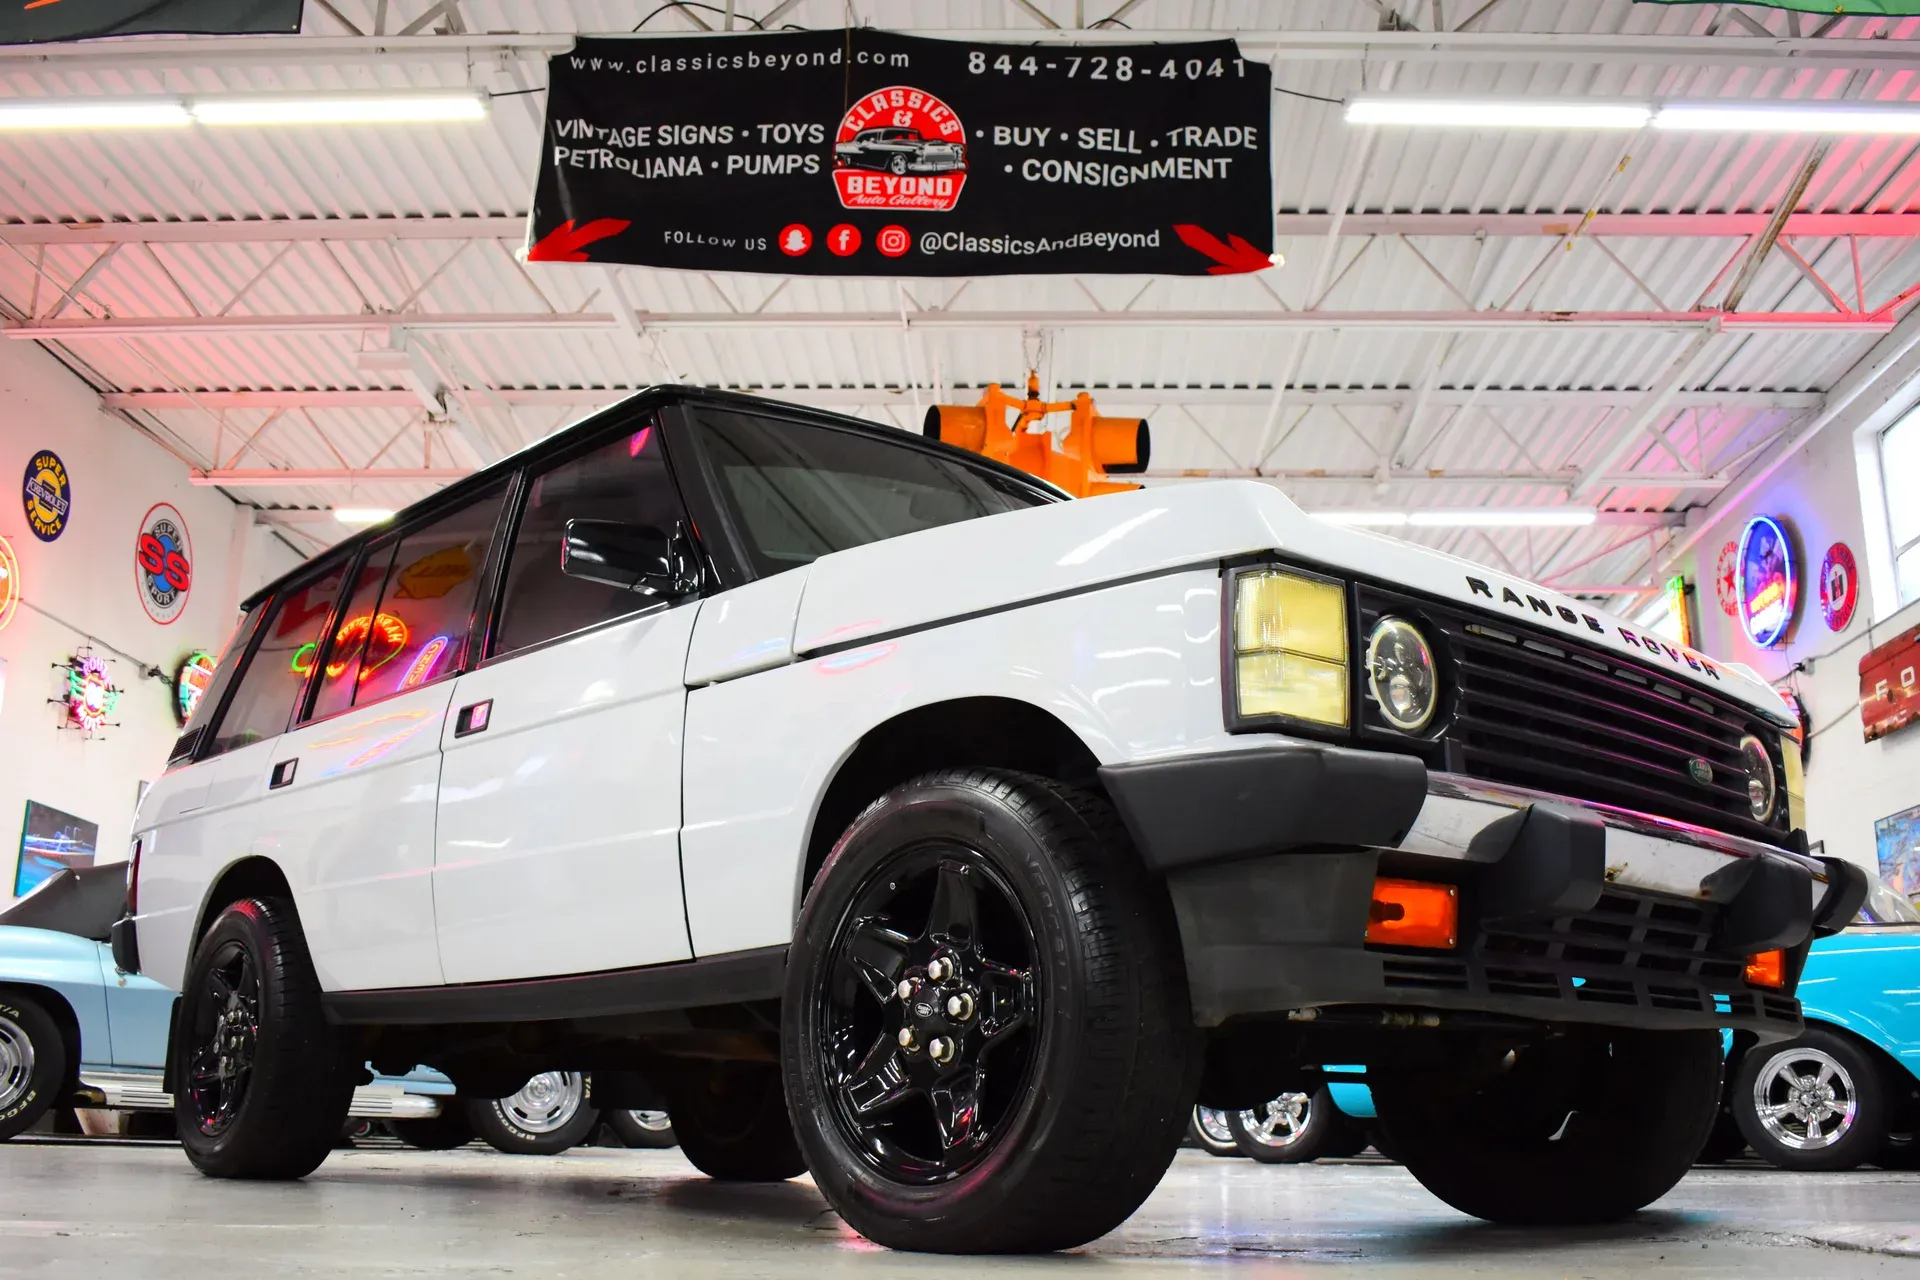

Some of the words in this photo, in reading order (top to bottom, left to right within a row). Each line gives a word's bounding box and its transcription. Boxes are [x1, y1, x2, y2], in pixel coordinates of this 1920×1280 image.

[570, 47, 910, 75] www.classicsbeyond.com
[968, 51, 1246, 82] 844-728-4041
[845, 90, 960, 136] CLASSICS
[892, 110, 913, 127] &
[555, 118, 651, 148] VINTAGE
[657, 124, 734, 146] SIGNS
[757, 123, 825, 145] TOYS
[993, 125, 1051, 148] BUY
[1077, 127, 1142, 154] SELL
[1166, 126, 1258, 150] TRADE
[553, 146, 704, 179] PETROLIANA
[727, 154, 820, 176] PUMPS
[1022, 157, 1233, 187] CONSIGNMENT
[847, 176, 953, 196] BEYOND
[848, 194, 886, 205] Auto
[888, 194, 949, 210] Gallery
[663, 230, 736, 248] FOLLOW
[745, 236, 767, 251] US
[919, 228, 1161, 256] @ClassicsAndBeyond
[35, 456, 67, 487] SUPER
[27, 500, 62, 536] SERVICE
[139, 532, 190, 592] SS
[1466, 576, 1604, 633] RANGE
[1617, 627, 1720, 680] ROVER
